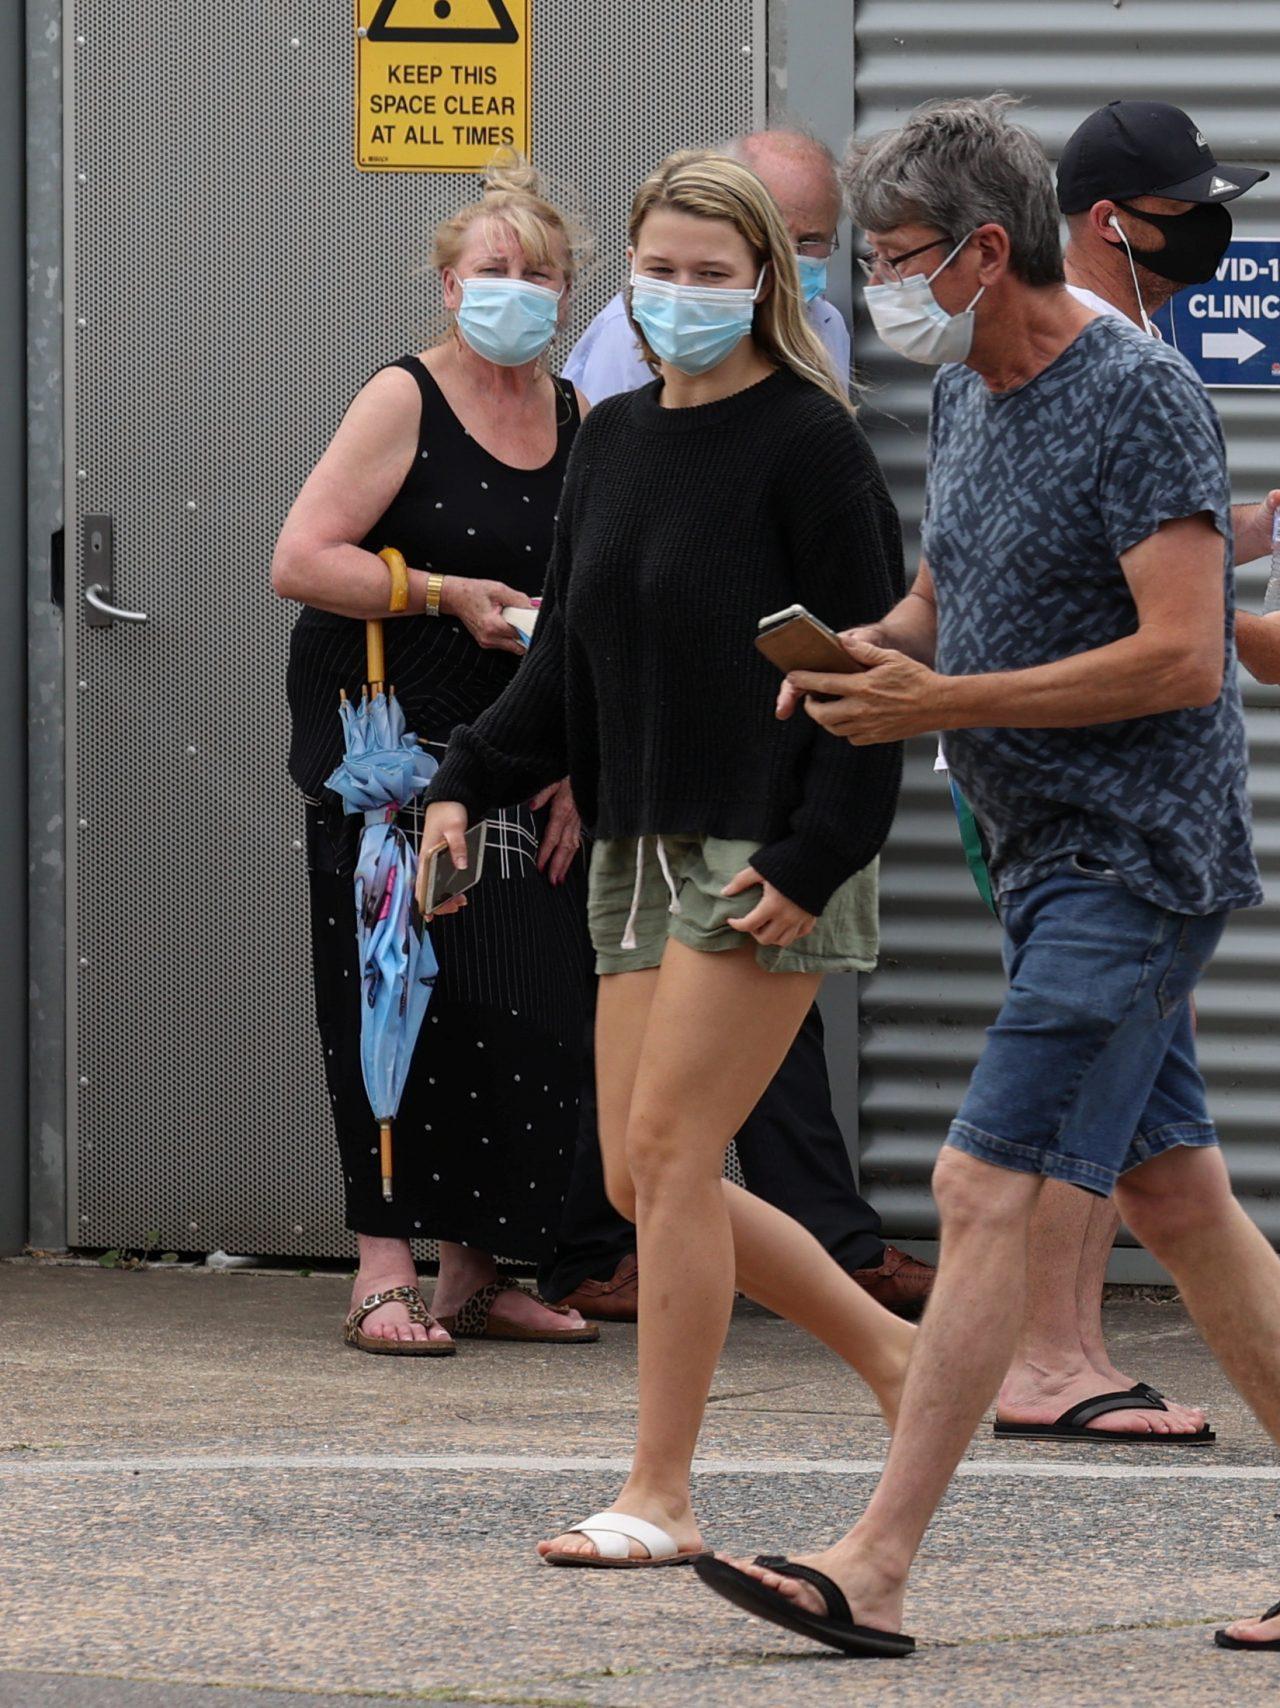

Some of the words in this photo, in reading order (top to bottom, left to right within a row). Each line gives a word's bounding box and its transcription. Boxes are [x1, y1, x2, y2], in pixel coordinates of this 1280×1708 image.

[388, 65, 443, 84] KEEP
[450, 66, 497, 85] THIS
[370, 94, 436, 114] SPACE
[444, 96, 515, 115] CLEAR
[371, 125, 396, 143] AT
[404, 126, 444, 144] ALL
[452, 126, 514, 145] TIMES
[1188, 294, 1280, 319] CLINIC
